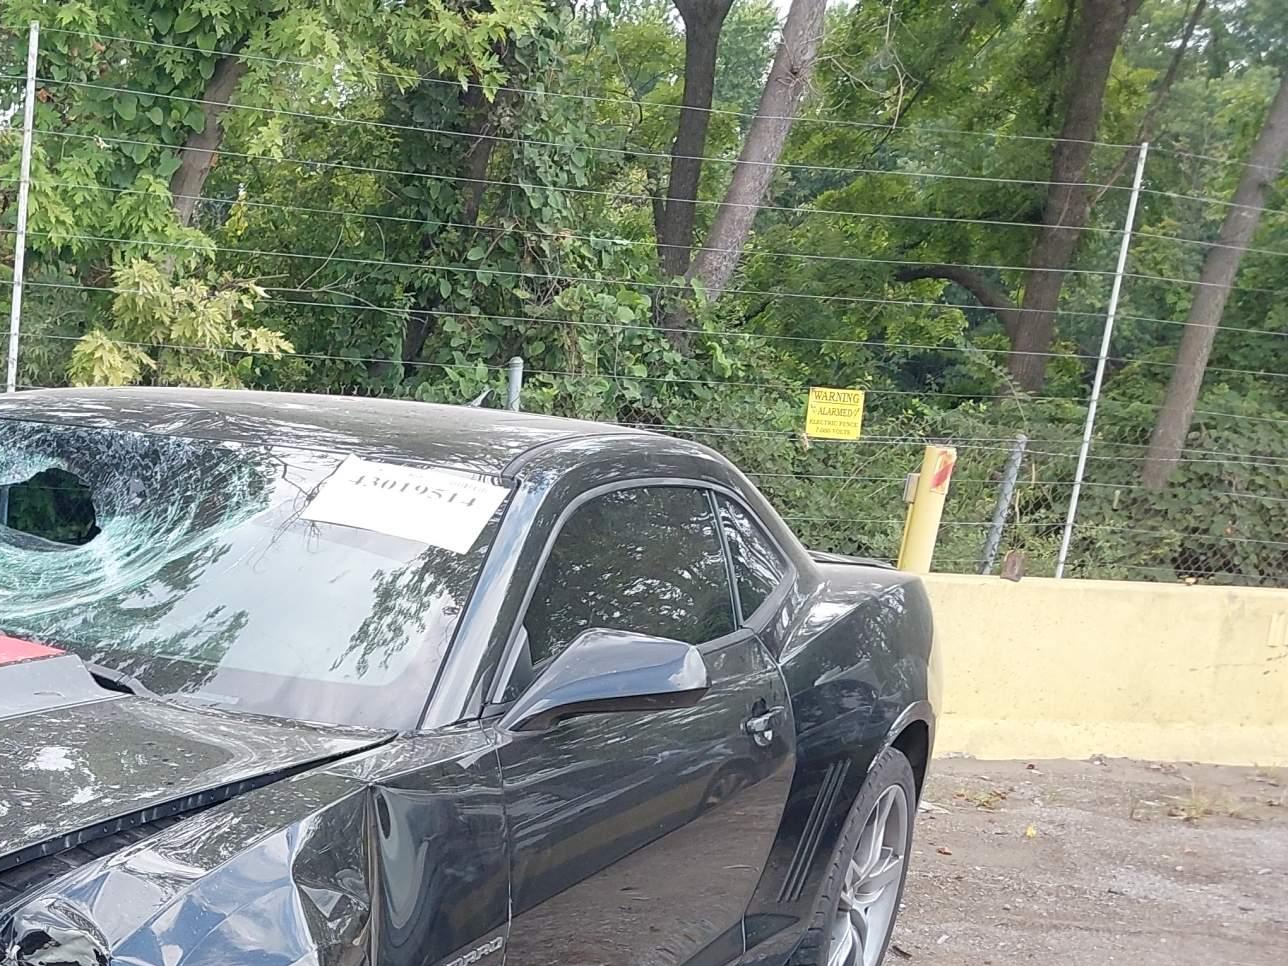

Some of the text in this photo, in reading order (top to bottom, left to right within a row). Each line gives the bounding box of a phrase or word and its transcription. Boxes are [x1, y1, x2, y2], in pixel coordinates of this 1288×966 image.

[813, 390, 860, 404] WARNING
[817, 406, 852, 417] ALARMED
[348, 474, 477, 507] 43019514
